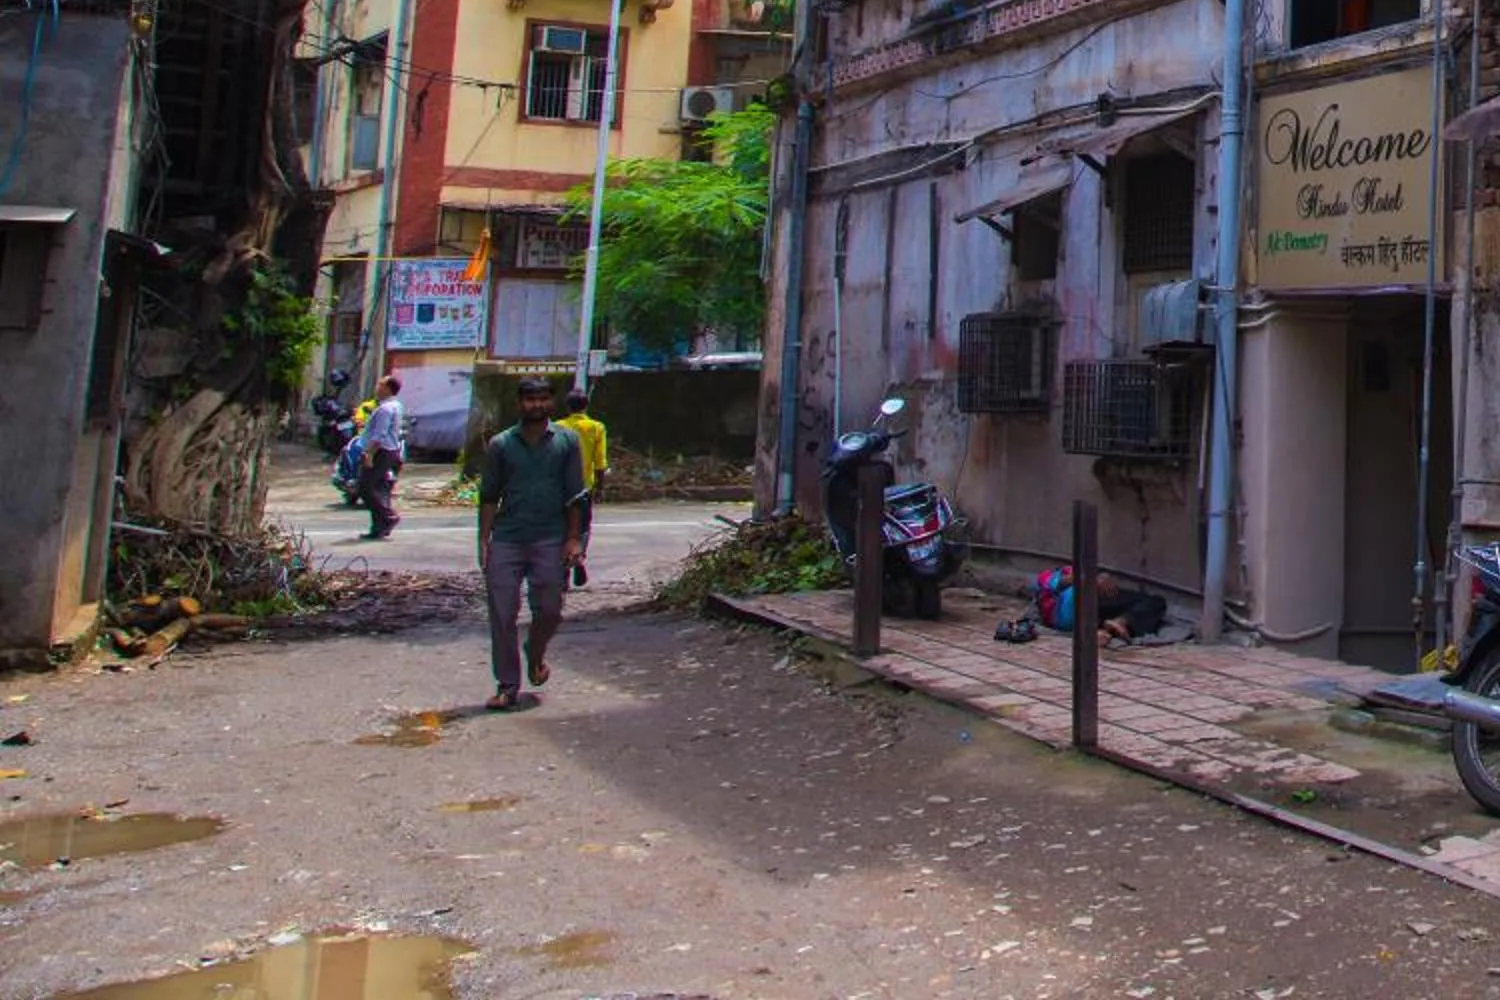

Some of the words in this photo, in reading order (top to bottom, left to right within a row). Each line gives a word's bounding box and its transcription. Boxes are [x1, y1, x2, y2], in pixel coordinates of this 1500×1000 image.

[1265, 103, 1430, 173] Welcome
[1298, 183, 1348, 219] Hindu
[1352, 176, 1403, 215] Hotel
